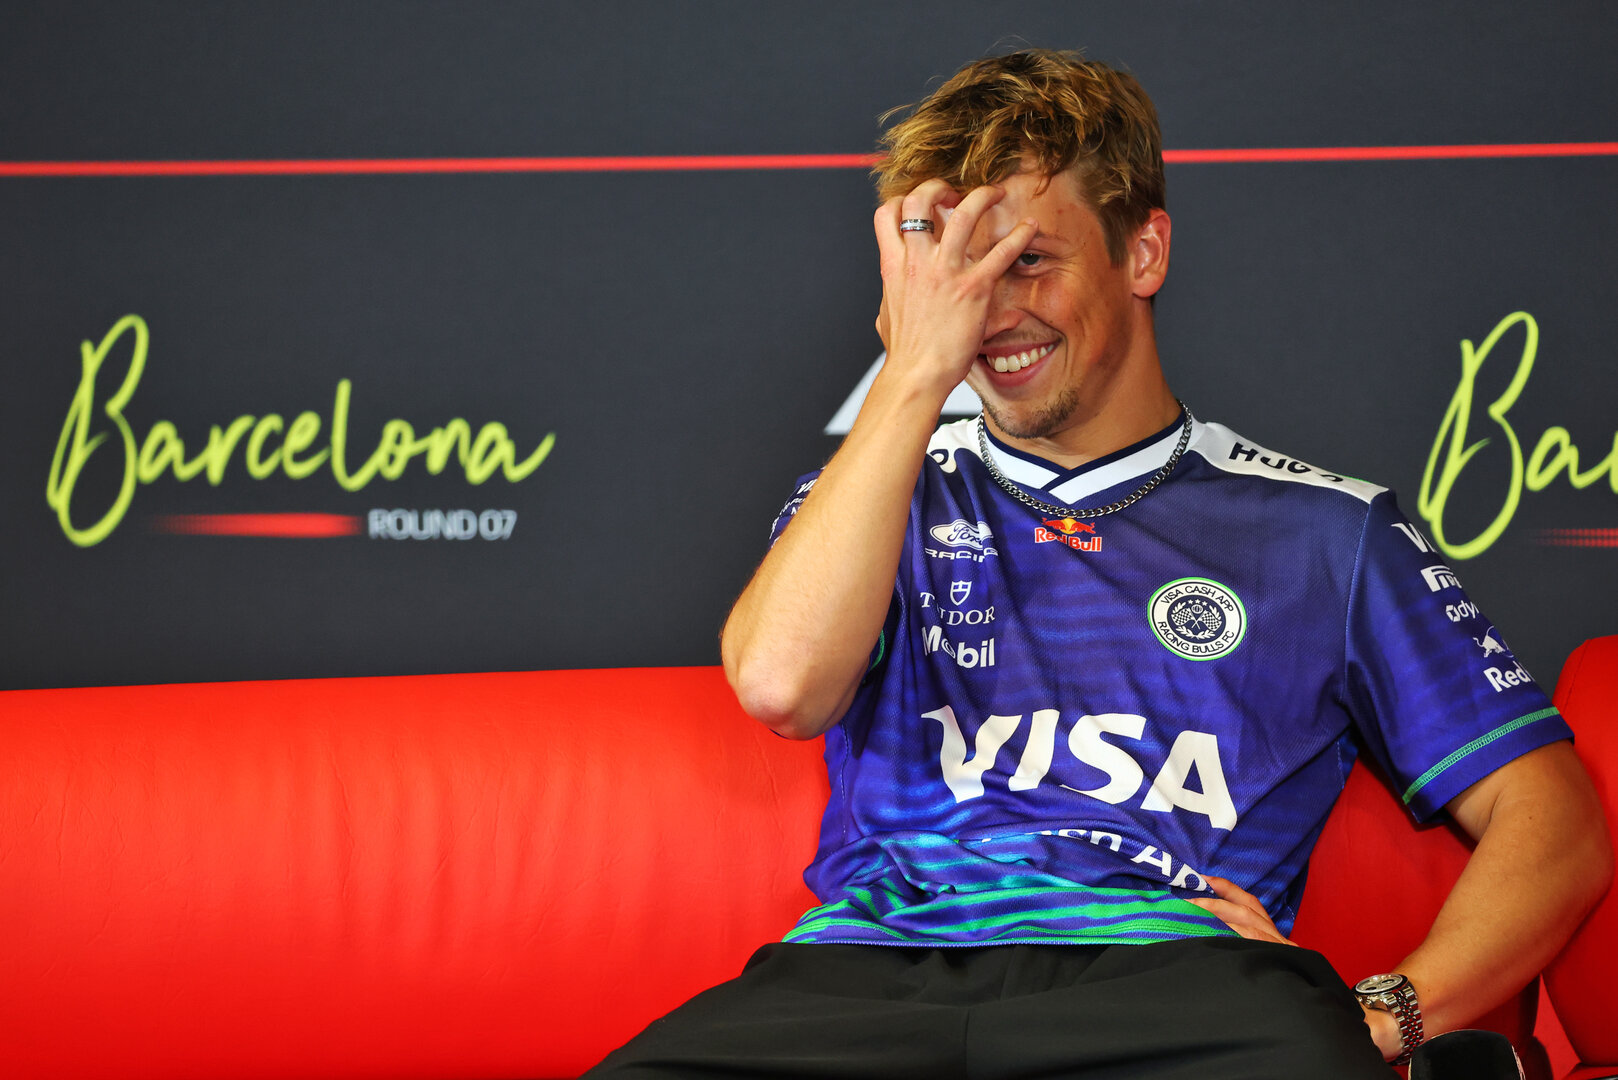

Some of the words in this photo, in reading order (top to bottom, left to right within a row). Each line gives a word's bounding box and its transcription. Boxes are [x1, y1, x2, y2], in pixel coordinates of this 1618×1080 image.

[47, 313, 557, 548] Barcelona
[368, 508, 478, 541] ROUND
[479, 509, 517, 541] 07
[1035, 527, 1067, 544] Red
[1068, 536, 1102, 552] Bull
[1161, 589, 1184, 605] VISA
[1185, 585, 1216, 597] CASH
[1215, 595, 1234, 612] APP
[921, 625, 995, 669] Mobil
[1158, 621, 1190, 651] RACING
[1192, 640, 1224, 654] BULLS
[1222, 630, 1235, 643] FC
[921, 705, 1238, 831] VISA
